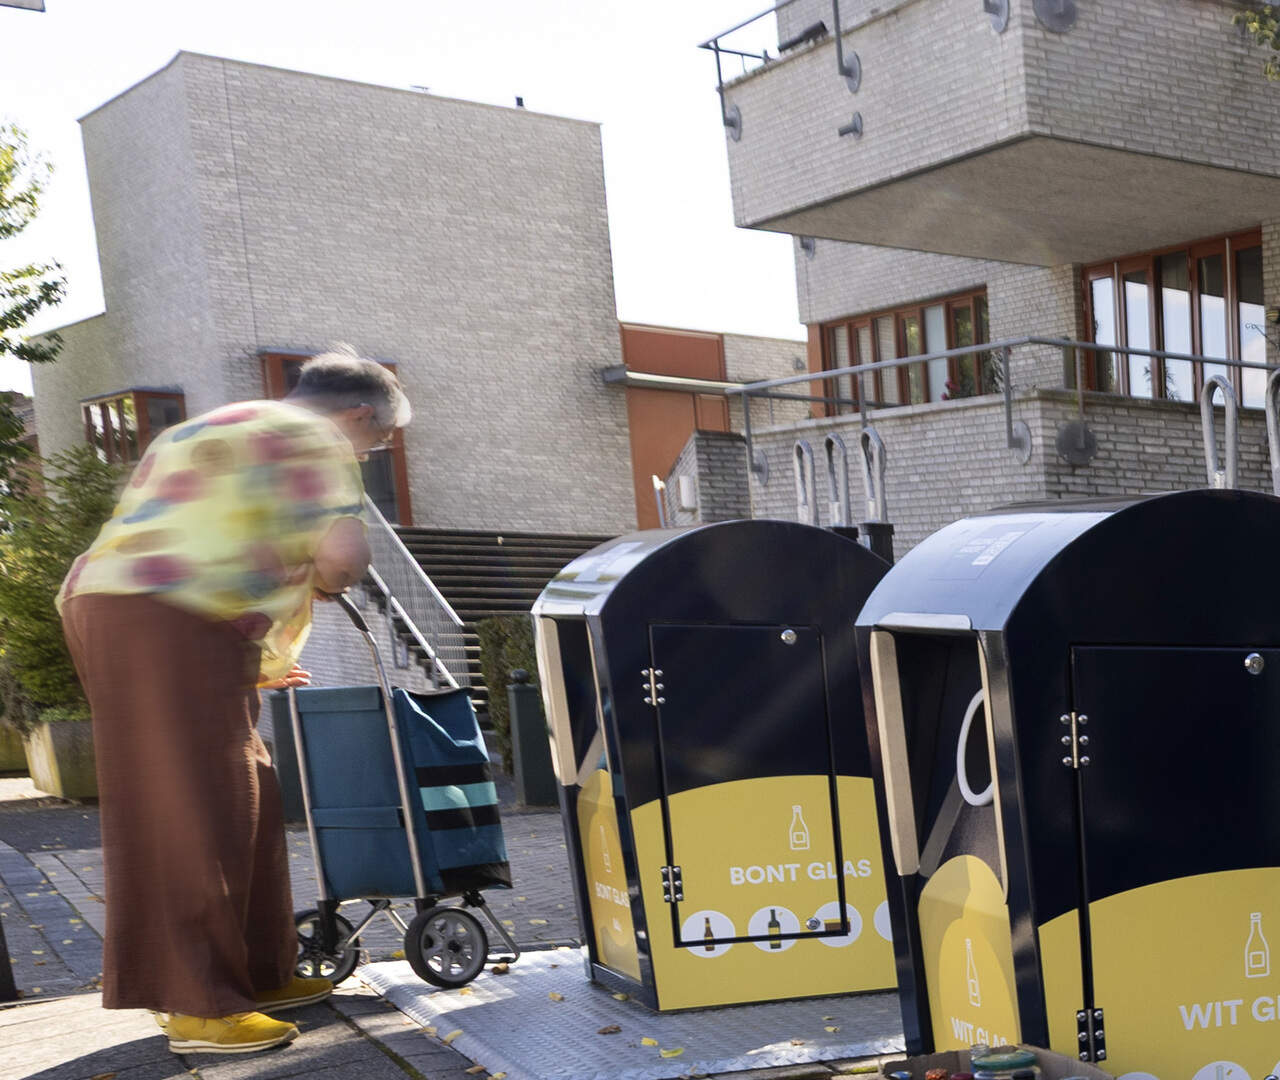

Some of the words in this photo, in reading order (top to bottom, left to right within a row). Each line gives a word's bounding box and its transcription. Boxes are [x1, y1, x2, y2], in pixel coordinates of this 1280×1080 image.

[730, 863, 800, 885] BONT
[807, 859, 872, 880] GLAS
[950, 1015, 974, 1046] WIT
[1178, 999, 1243, 1031] WIT
